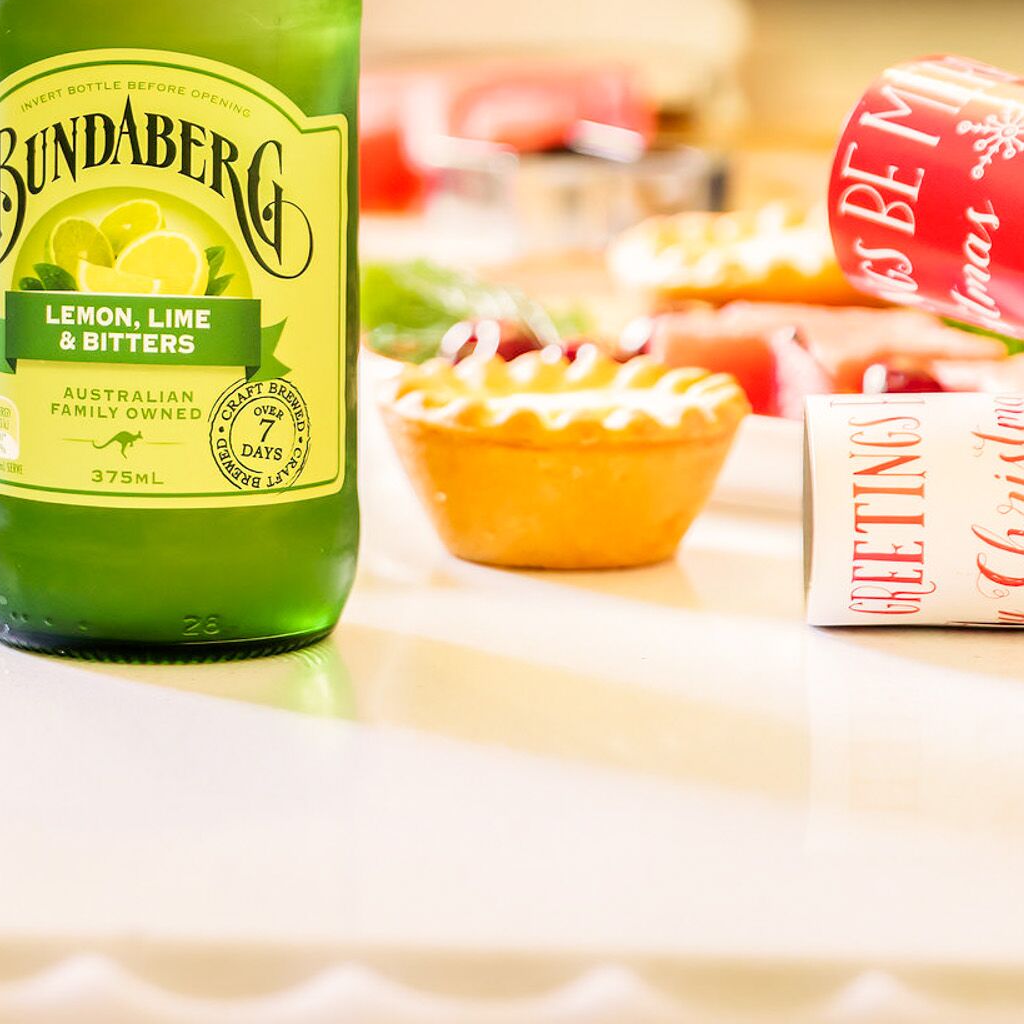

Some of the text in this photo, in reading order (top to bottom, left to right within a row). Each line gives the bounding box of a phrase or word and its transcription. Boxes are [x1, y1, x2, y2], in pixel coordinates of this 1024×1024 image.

[20, 80, 252, 119] INVERT BOTTLE BEFORE OPENING
[838, 142, 926, 237] BE
[44, 303, 212, 332] LEMON, LIME
[58, 330, 196, 355] & BITTERS
[62, 385, 195, 404] AUSTRALIAN
[221, 381, 306, 433] CRAFT BREWED
[49, 402, 204, 422] FAMILY OWNED
[253, 404, 285, 421] OVER
[258, 417, 276, 443] 7
[216, 437, 303, 489] CRAFT BREWED
[240, 442, 283, 462] DAYS
[847, 416, 937, 615] GREETINGS
